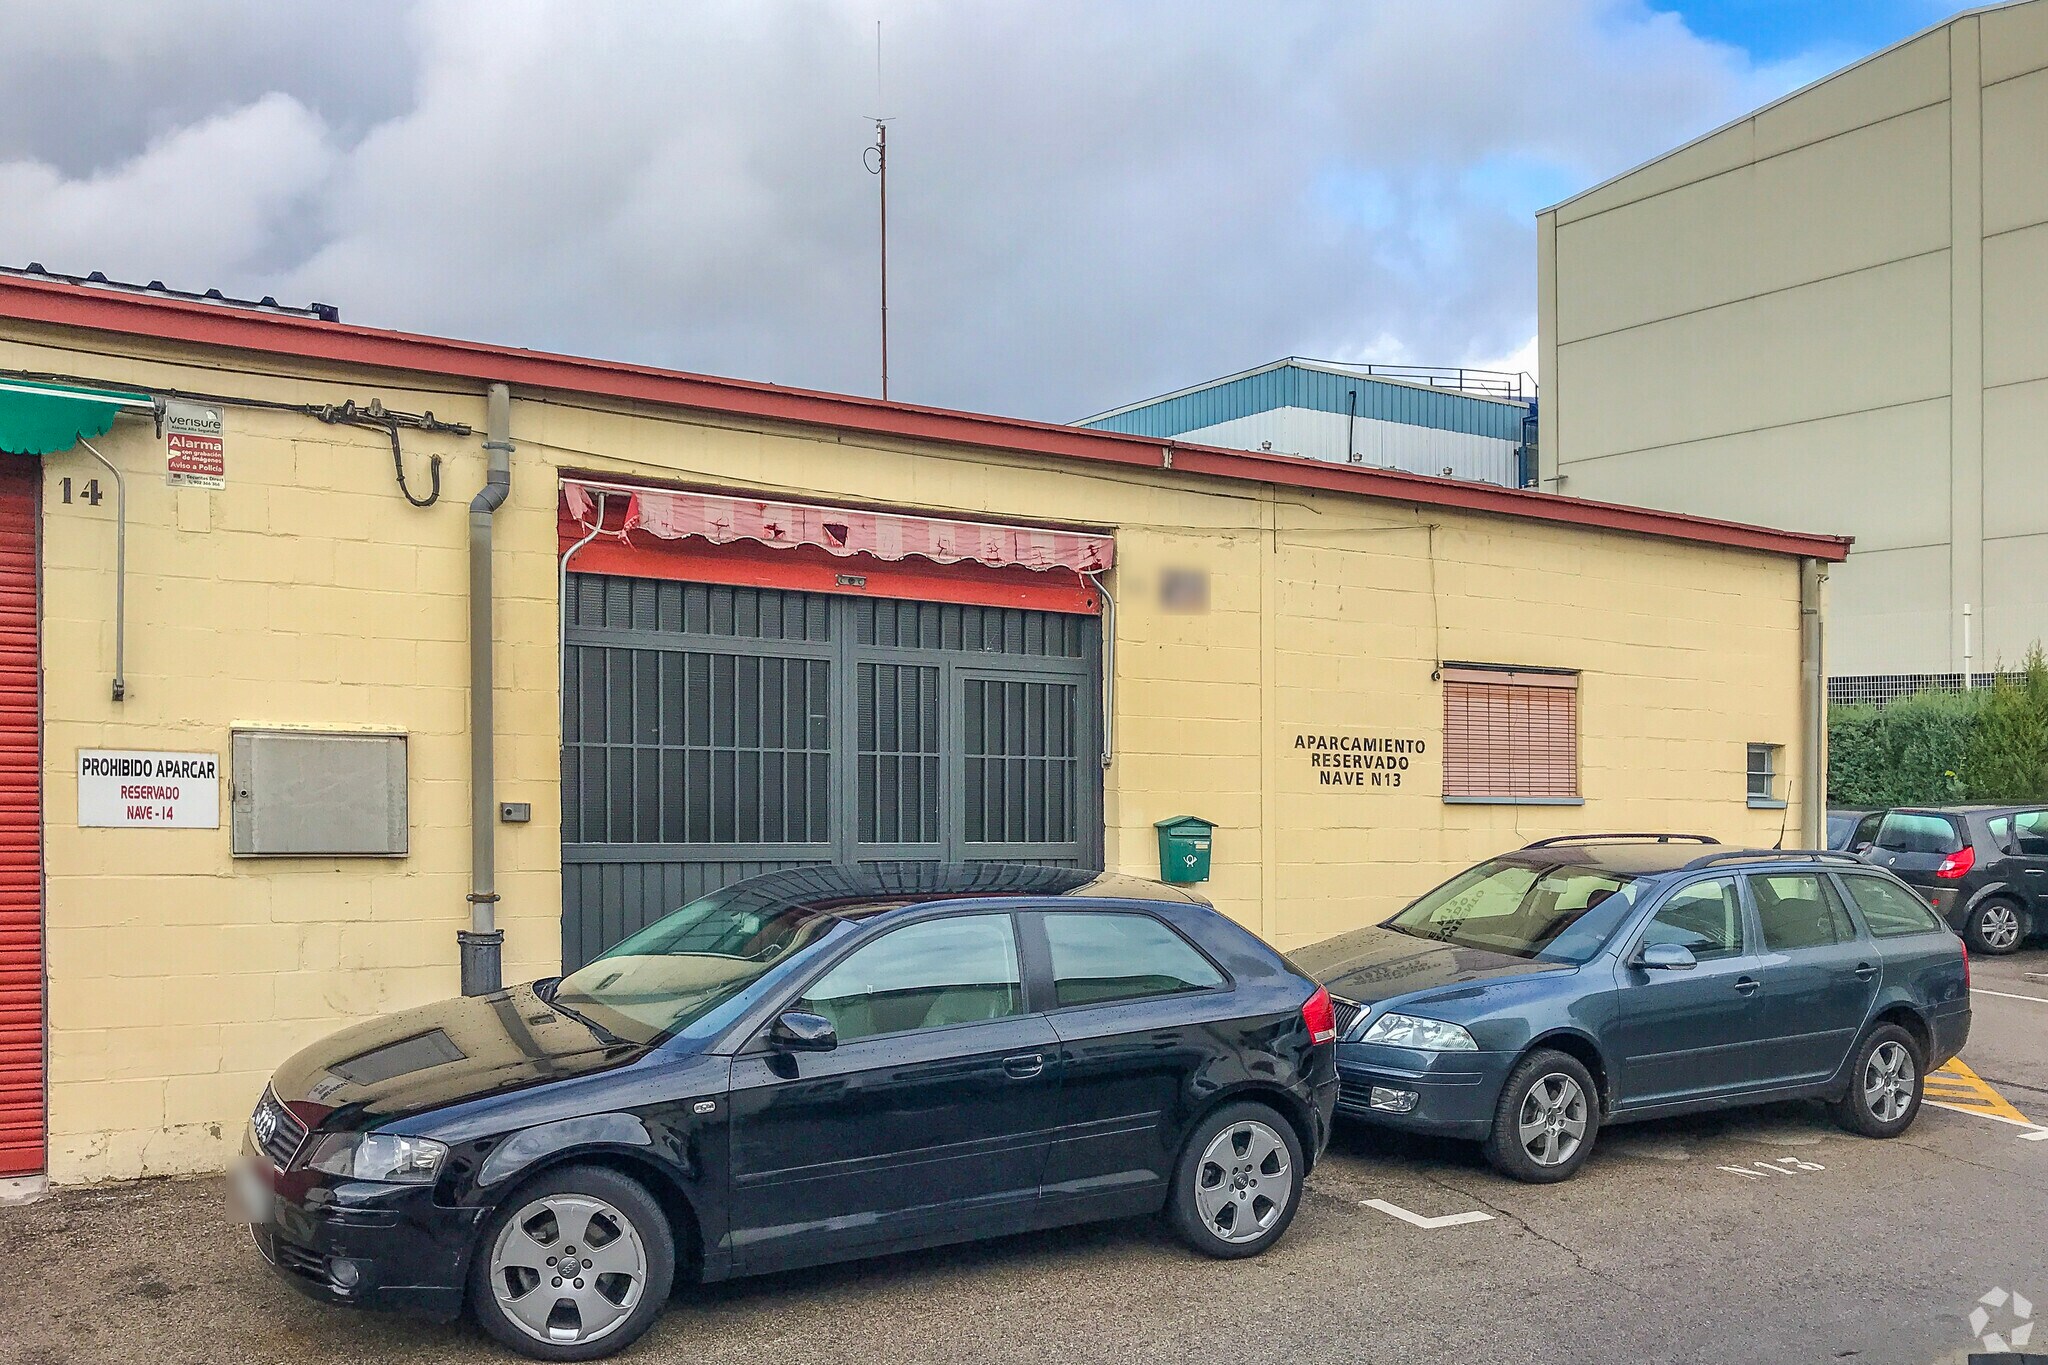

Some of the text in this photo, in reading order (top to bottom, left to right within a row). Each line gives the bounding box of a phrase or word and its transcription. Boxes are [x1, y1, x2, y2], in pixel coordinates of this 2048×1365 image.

[169, 416, 221, 429] verisure
[170, 436, 222, 451] Alarma
[193, 450, 222, 458] grabación
[170, 461, 191, 469] Aviso
[198, 464, 222, 472] Policía
[58, 477, 103, 506] 14
[1294, 735, 1426, 754] APARCAMIENTO
[82, 757, 216, 779] PROHIBIDO APARCAR
[1311, 752, 1409, 771] RESERVADO
[1319, 770, 1401, 787] NAVE N13
[120, 785, 180, 800] RESERVADO
[126, 805, 153, 820] NAVE
